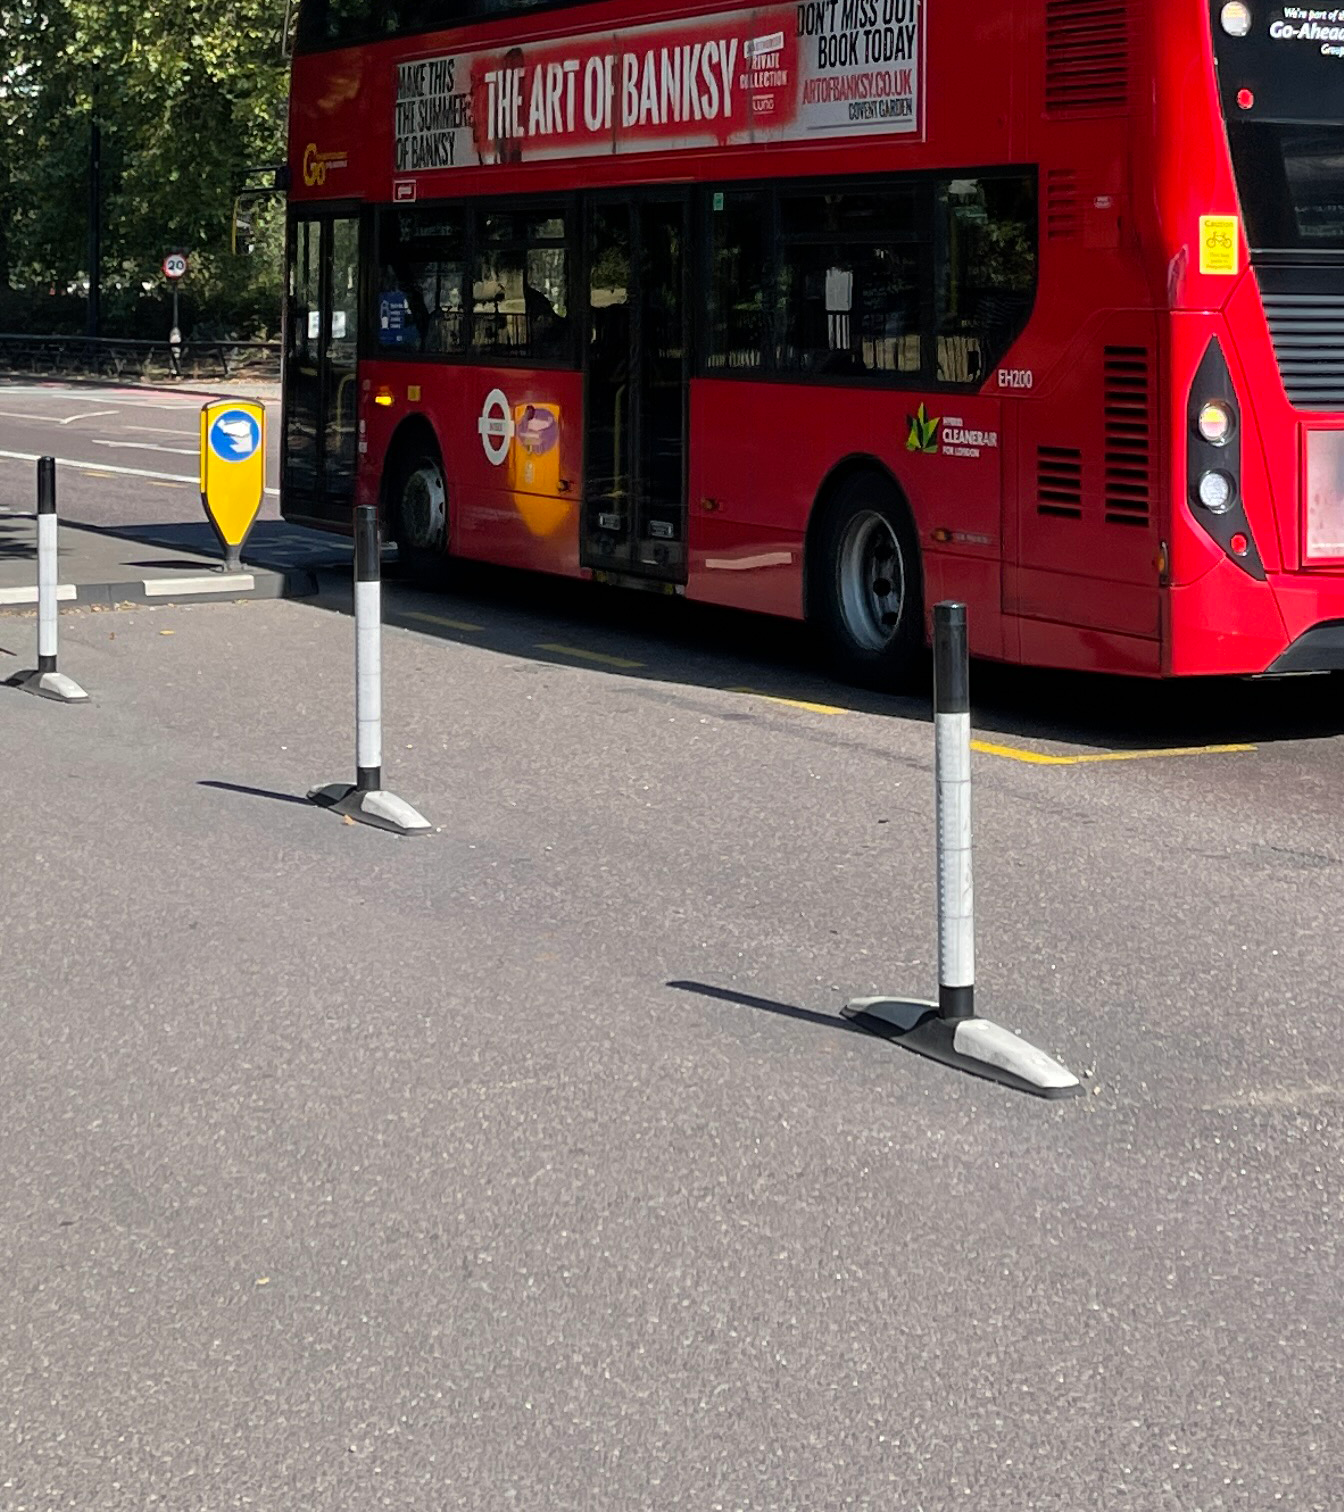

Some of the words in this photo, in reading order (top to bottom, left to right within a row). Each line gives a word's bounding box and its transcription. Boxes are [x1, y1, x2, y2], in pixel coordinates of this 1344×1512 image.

[797, 0, 838, 36] DON'T
[1308, 10, 1327, 21] part
[1328, 10, 1338, 22] of
[818, 31, 860, 69] BOOK
[863, 24, 917, 64] TODAY
[397, 62, 425, 98] MAKE
[427, 58, 455, 93] THIS
[484, 68, 524, 140] THE
[528, 60, 580, 136] ART
[584, 55, 617, 131] OF
[622, 37, 738, 128] BANKSY
[802, 69, 913, 105] ARTOFBANKSY.CO.UK
[396, 100, 416, 135] THE
[849, 100, 878, 120] COVENT
[879, 98, 913, 118] GARDEN
[396, 136, 409, 170] OF
[411, 131, 456, 168] BANKSY
[167, 260, 184, 270] 20
[998, 369, 1033, 388] EH200
